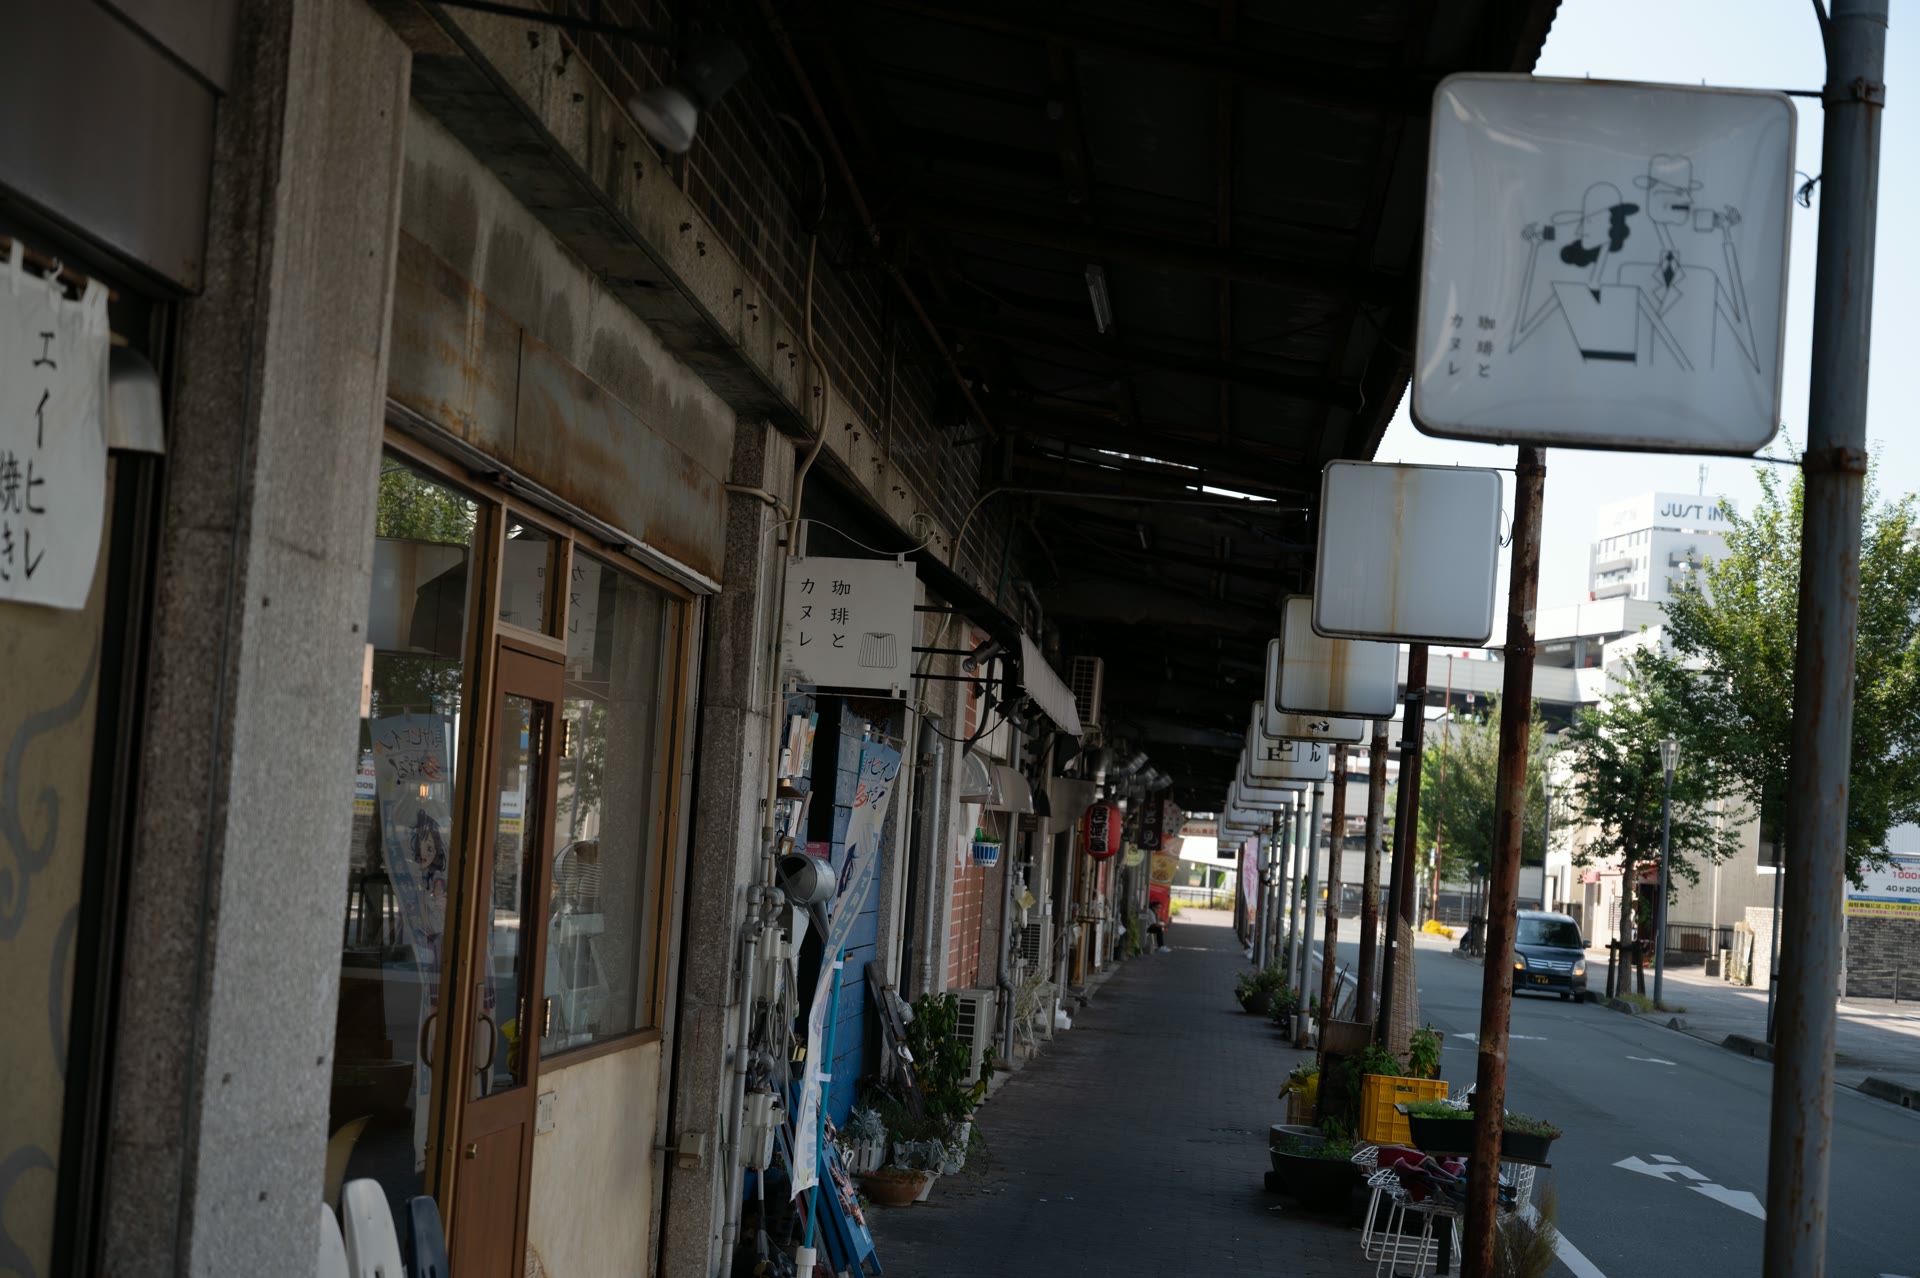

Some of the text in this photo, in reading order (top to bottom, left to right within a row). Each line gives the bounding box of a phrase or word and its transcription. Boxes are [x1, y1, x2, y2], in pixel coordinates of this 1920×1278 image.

[1448, 314, 1463, 376] カヌレ
[1477, 314, 1496, 378] 珈琲と
[25, 331, 57, 580] エイヒレ
[1660, 503, 1703, 520] JUST
[800, 578, 815, 647] カヌレ
[830, 580, 851, 648] 珈琲と
[1090, 806, 1108, 852] 居酒屋
[1893, 871, 1920, 880] 1000
